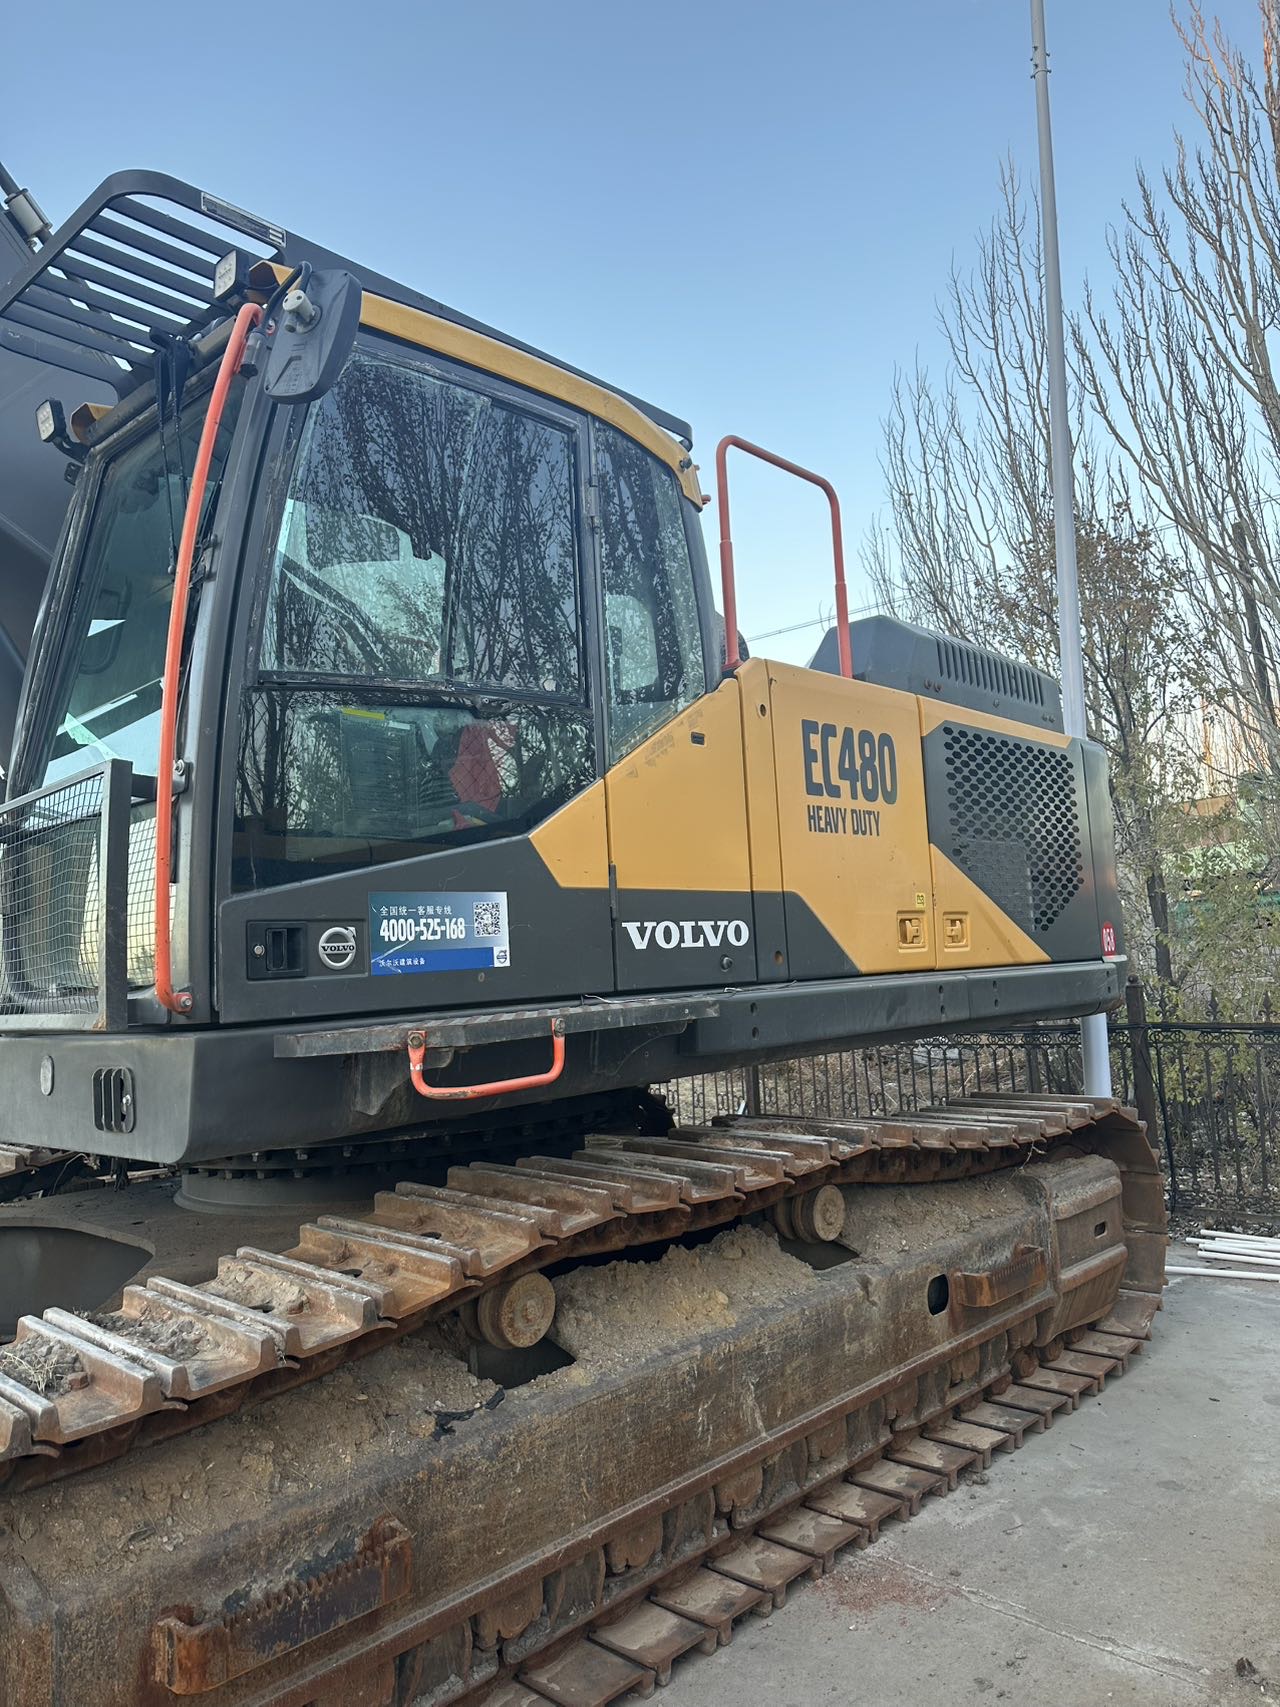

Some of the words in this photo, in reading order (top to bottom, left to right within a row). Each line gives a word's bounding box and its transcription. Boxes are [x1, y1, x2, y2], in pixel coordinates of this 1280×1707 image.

[801, 719, 898, 805] EC480
[807, 804, 847, 835] HEAVY
[850, 808, 880, 837] DUTY
[379, 905, 452, 916] 全国统一客服专线
[379, 917, 466, 942] 4000-525-168
[621, 920, 750, 950] VOLVO
[321, 944, 355, 952] VOLVO
[379, 957, 426, 967] 沃尔沃建筑设备
